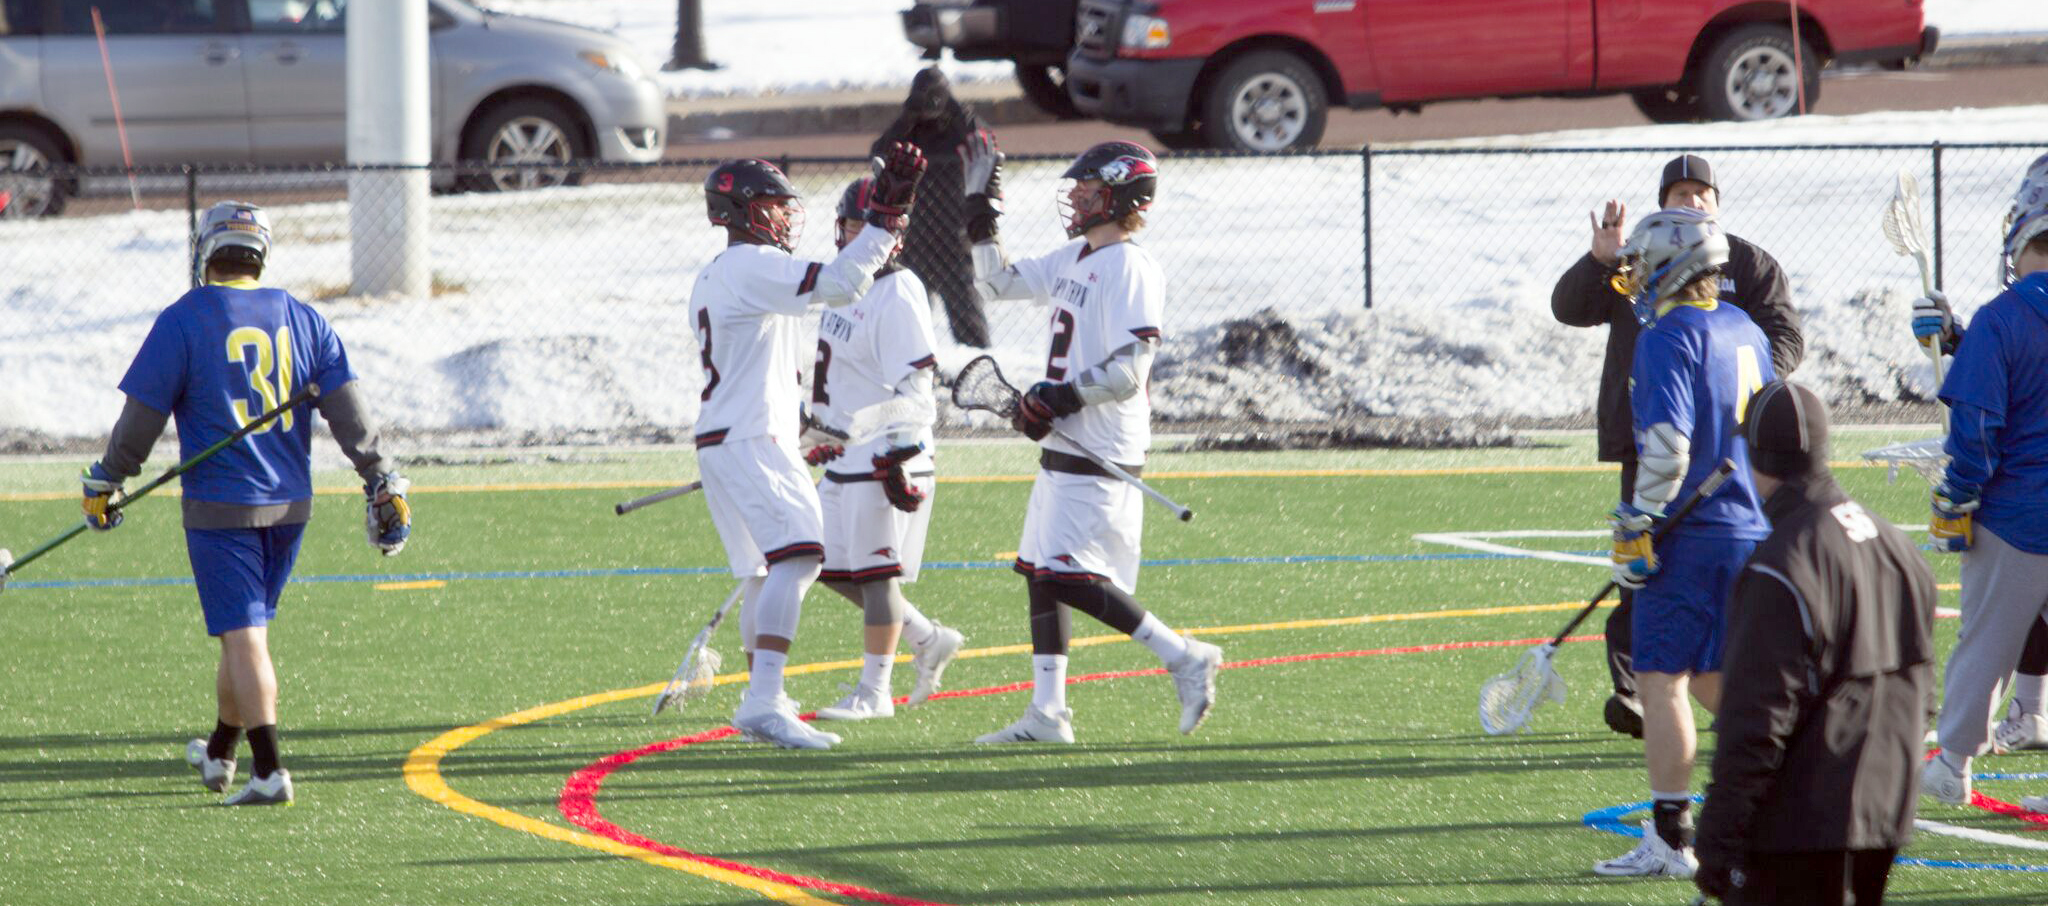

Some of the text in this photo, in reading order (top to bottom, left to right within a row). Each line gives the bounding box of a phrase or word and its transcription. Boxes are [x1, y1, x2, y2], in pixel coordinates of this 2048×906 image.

[718, 172, 734, 193] 3
[1669, 225, 1684, 248] 4
[225, 325, 294, 435] 31
